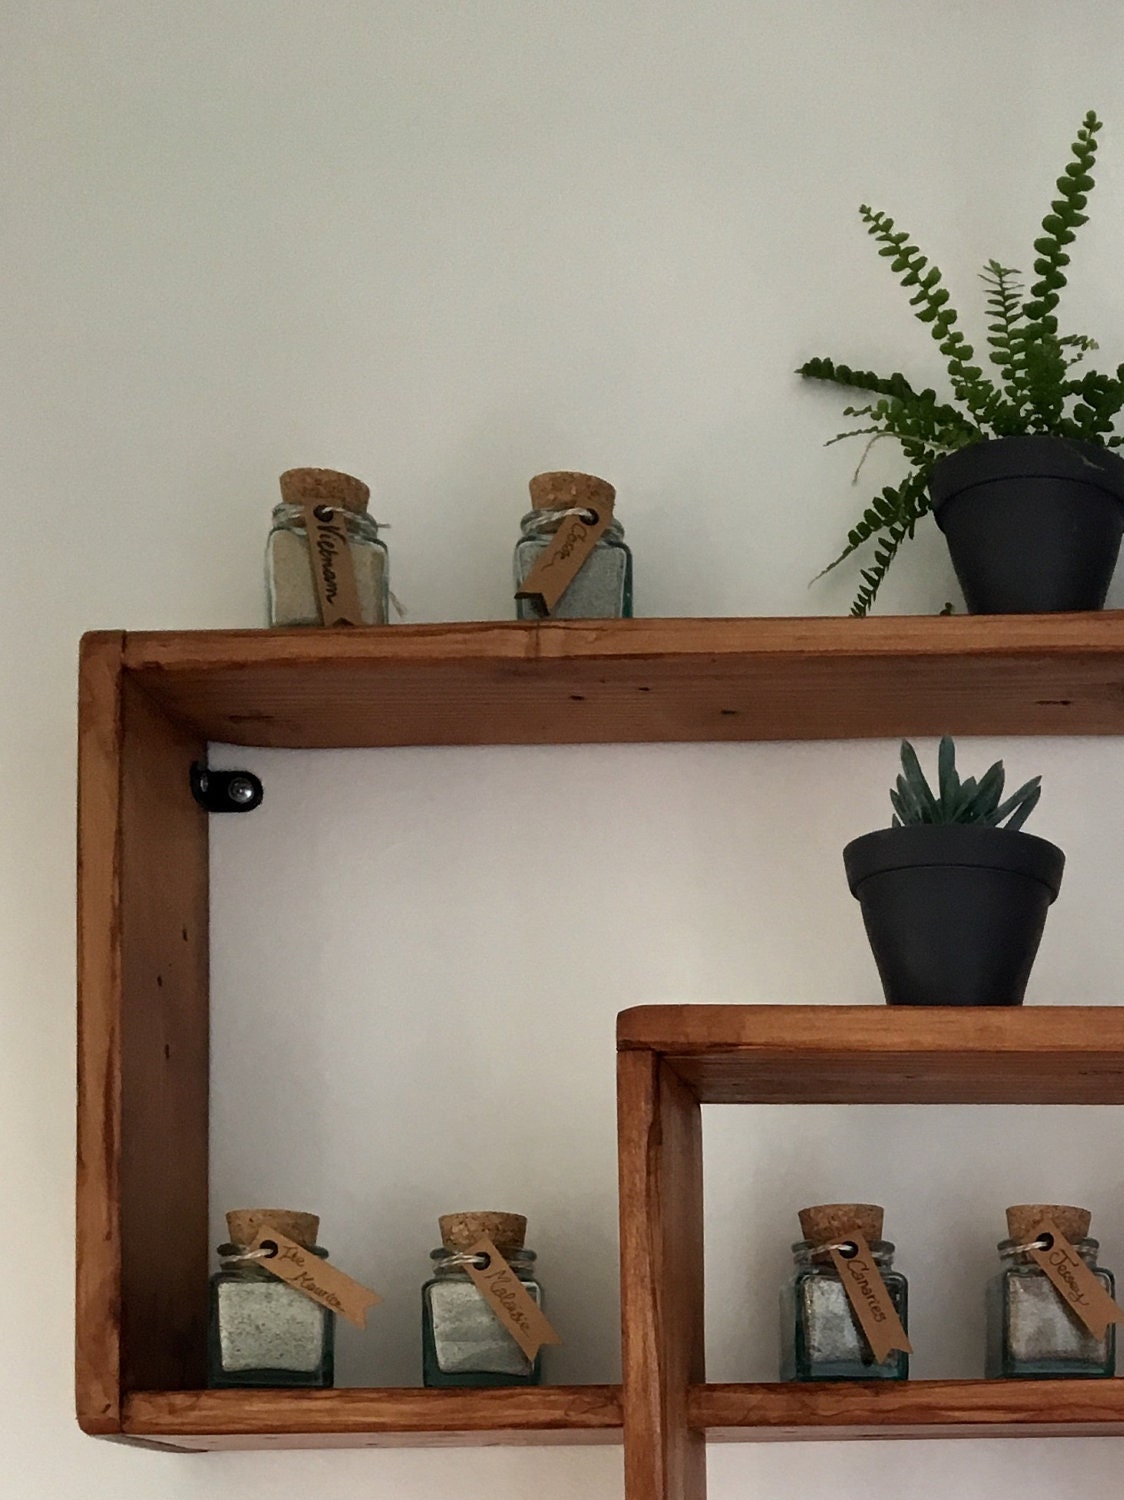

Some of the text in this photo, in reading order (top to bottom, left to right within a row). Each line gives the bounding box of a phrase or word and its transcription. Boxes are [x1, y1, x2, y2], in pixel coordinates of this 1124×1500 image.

[316, 524, 347, 605] Vietnam
[484, 1268, 532, 1338] Malaisie
[846, 1259, 886, 1324] Canaries
